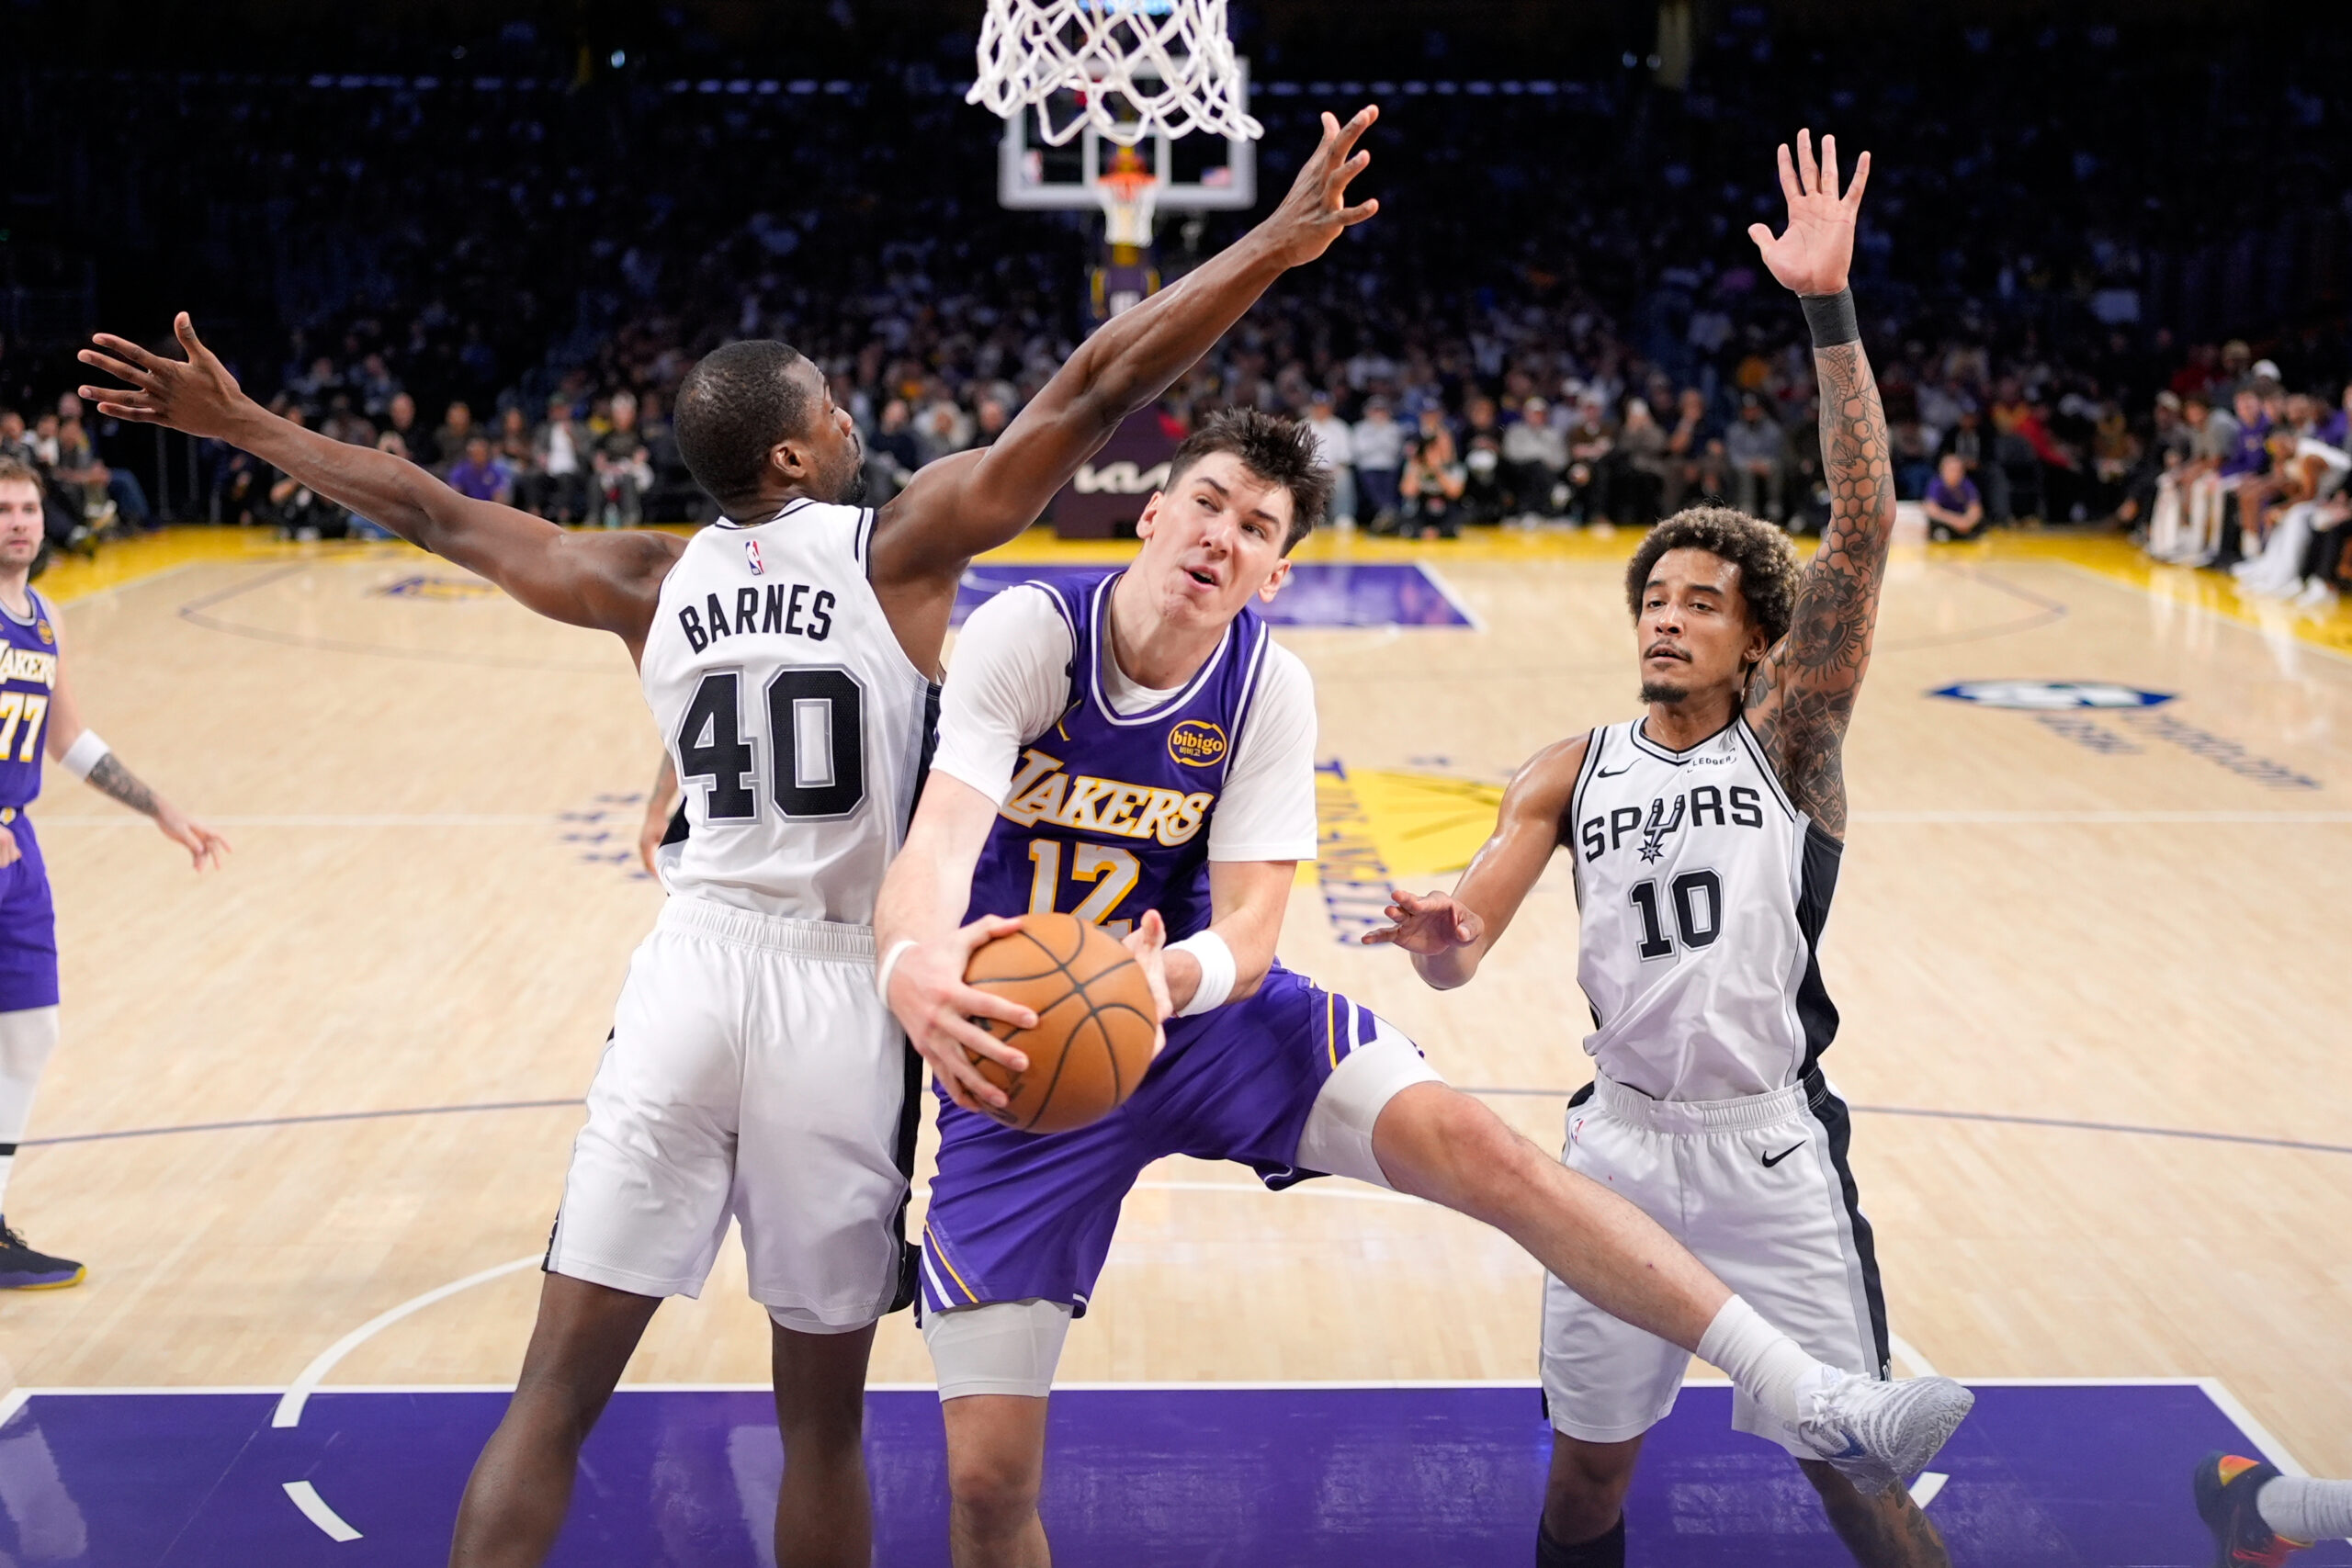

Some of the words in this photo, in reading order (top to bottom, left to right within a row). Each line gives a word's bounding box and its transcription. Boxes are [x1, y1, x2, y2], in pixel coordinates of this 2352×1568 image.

[678, 583, 836, 655] BARNES
[0, 692, 49, 763] 77
[674, 664, 867, 826] 40
[1172, 729, 1224, 755] bibigo
[1692, 755, 1732, 768] LEDGER
[999, 749, 1215, 847] LAKERS
[1582, 785, 1763, 865] SPURS
[1028, 838, 1141, 941] 12
[1628, 867, 1724, 963] 10
